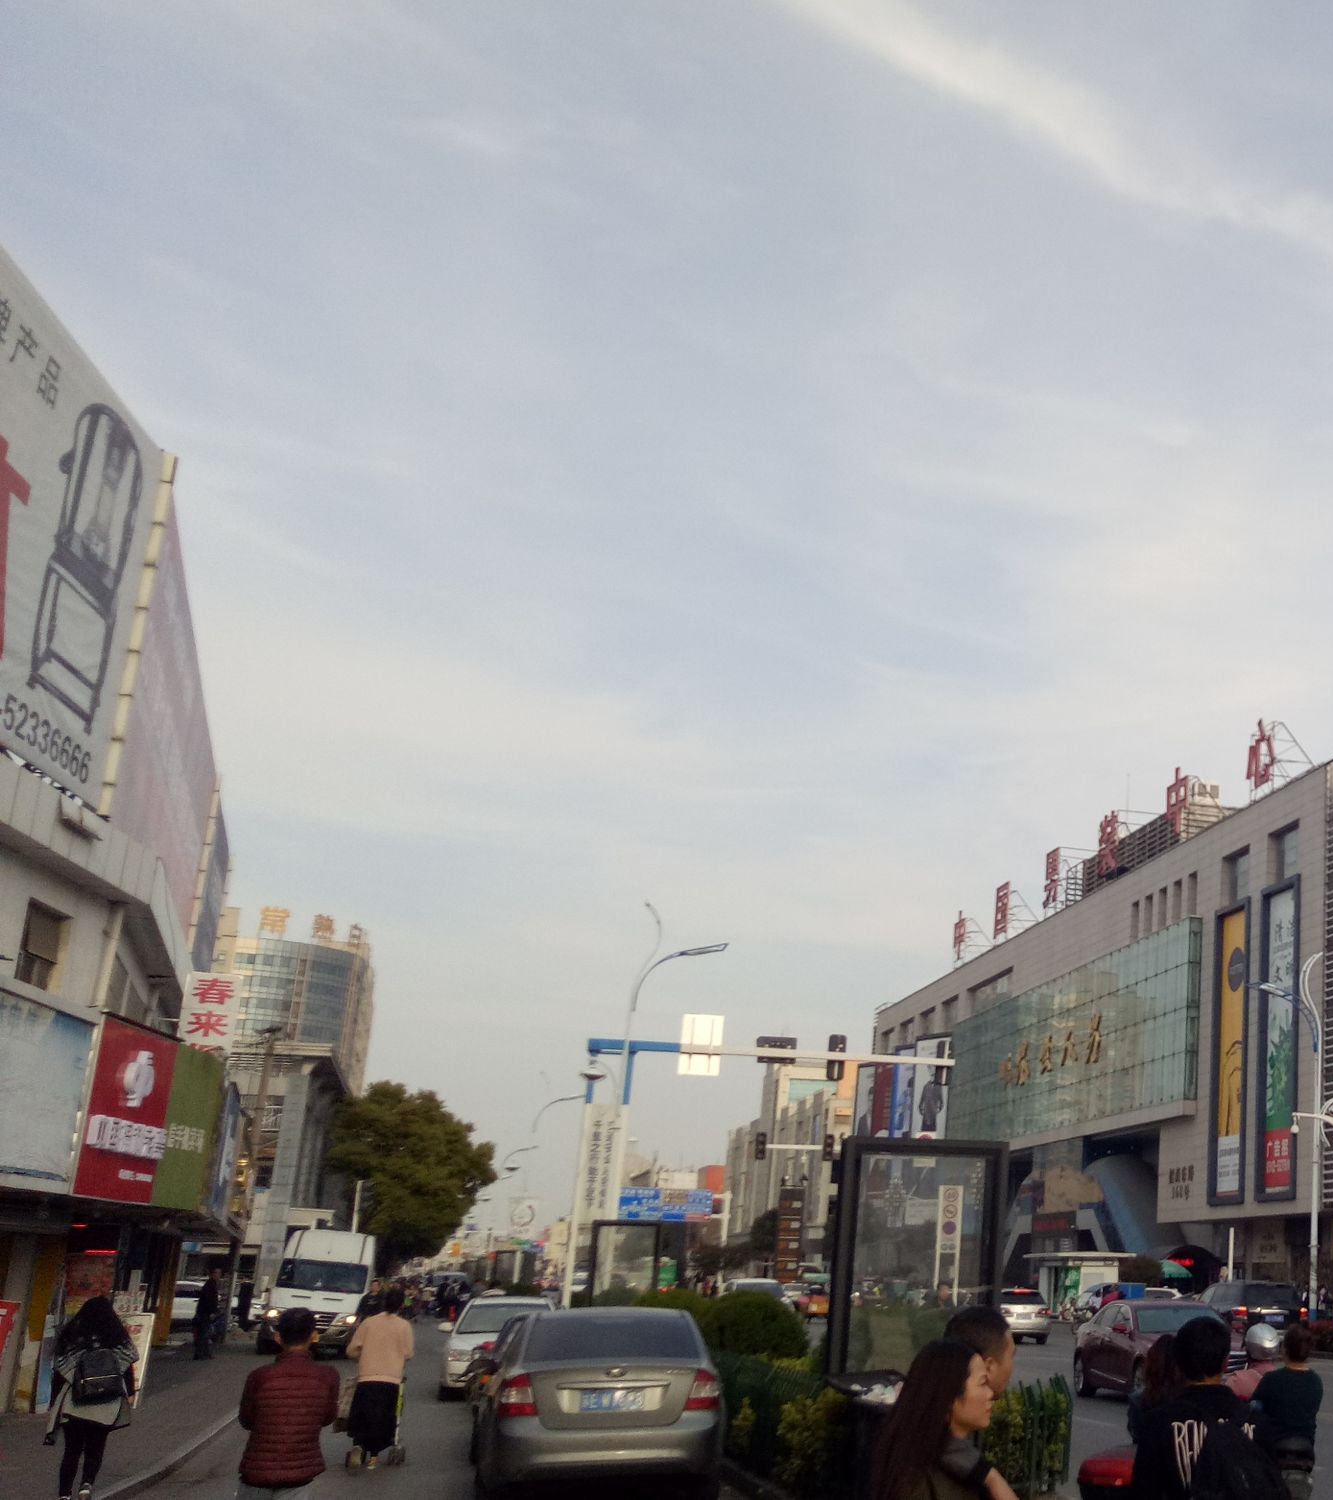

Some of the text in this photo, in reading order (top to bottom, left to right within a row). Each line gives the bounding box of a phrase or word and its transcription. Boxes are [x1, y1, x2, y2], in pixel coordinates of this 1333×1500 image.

[953, 718, 1275, 961] 中国男装中心
